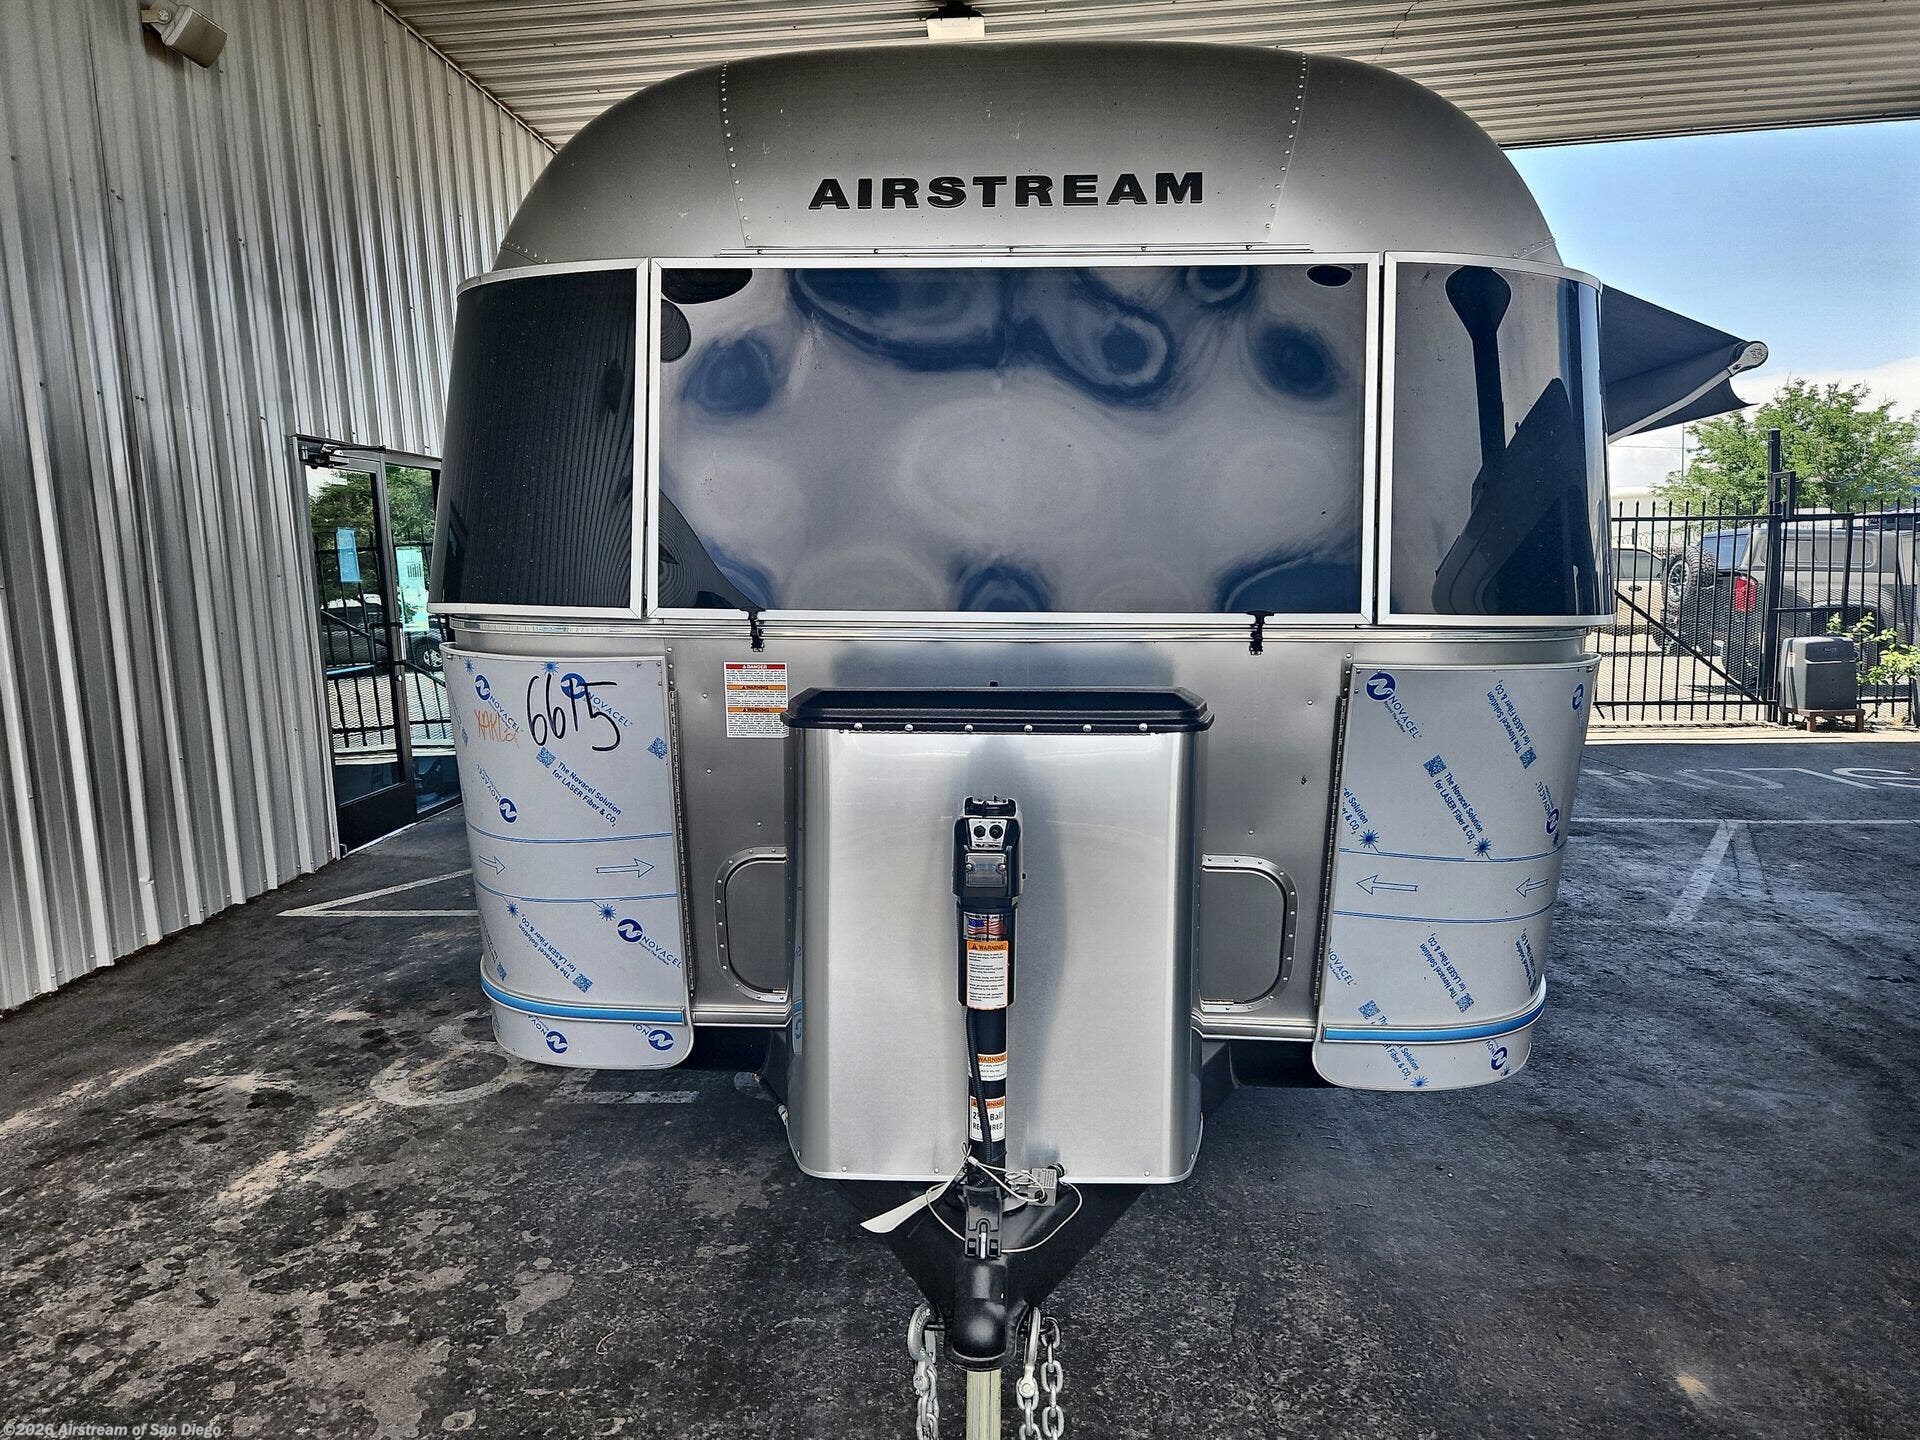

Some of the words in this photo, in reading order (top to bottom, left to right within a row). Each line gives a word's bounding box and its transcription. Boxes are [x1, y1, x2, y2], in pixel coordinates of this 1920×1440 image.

[808, 172, 1203, 210] AIRSTREAM
[490, 695, 520, 734] NOVACEL
[1390, 695, 1419, 739] NOVACEL
[552, 769, 563, 780] for
[561, 777, 584, 798] LASER
[582, 794, 600, 811] Fiber
[557, 761, 570, 775] The
[569, 771, 597, 795] Novacel
[594, 792, 622, 816] Solution
[1433, 779, 1444, 790] for
[1439, 788, 1457, 811] LASER
[1452, 808, 1466, 826] Fiber
[1444, 771, 1455, 787] The
[1451, 783, 1471, 810] Novacel
[1465, 807, 1483, 834] Solution
[1348, 796, 1369, 825] Solution
[641, 936, 682, 969] NOVACEL
[1378, 1015, 1388, 1025] Th
[1400, 1047, 1420, 1071] Solution
